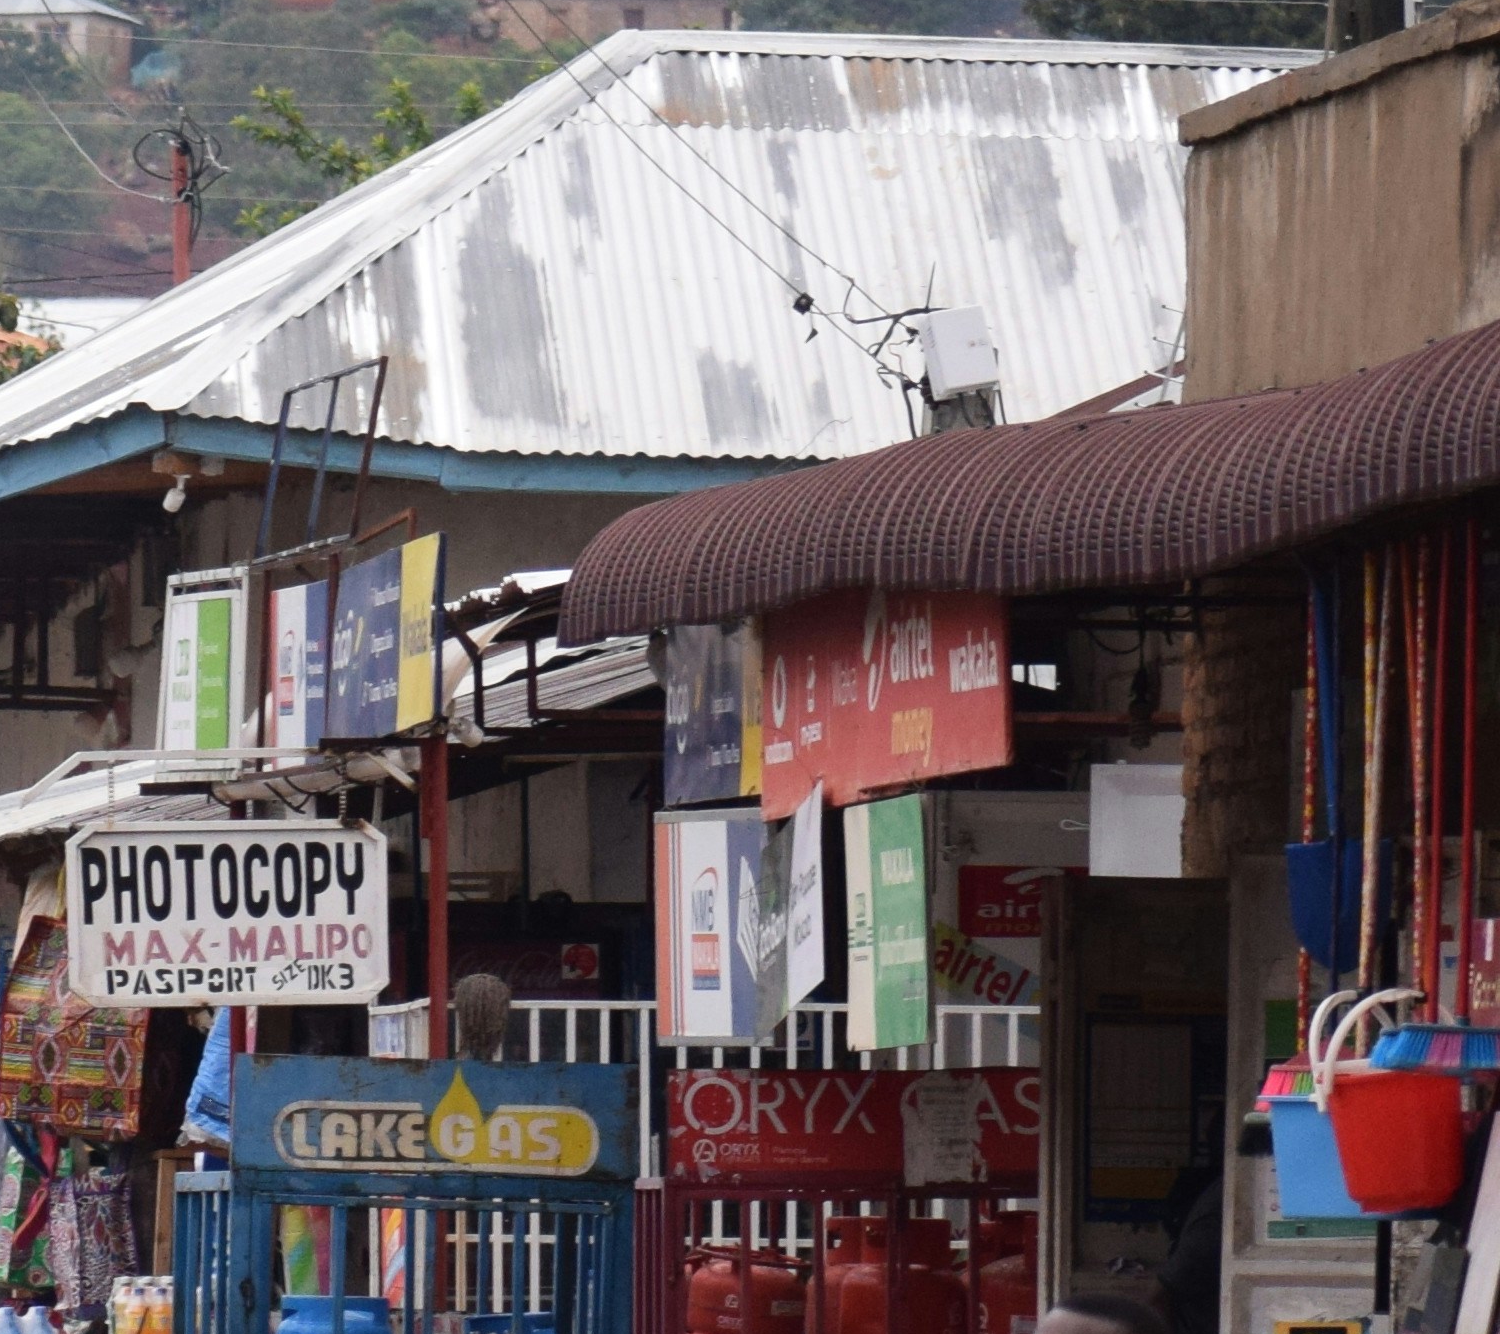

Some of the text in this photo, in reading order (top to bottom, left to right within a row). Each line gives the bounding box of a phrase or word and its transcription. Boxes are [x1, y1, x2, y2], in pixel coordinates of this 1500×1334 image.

[890, 602, 934, 684] airtel
[949, 627, 999, 693] wakala
[80, 842, 365, 925] PHOTOCOPY
[106, 958, 354, 995] PASPORT SIZE DK3
[934, 936, 1031, 1006] airtel
[292, 1112, 562, 1161] LAKE GAS
[684, 1077, 876, 1134] ORYX
